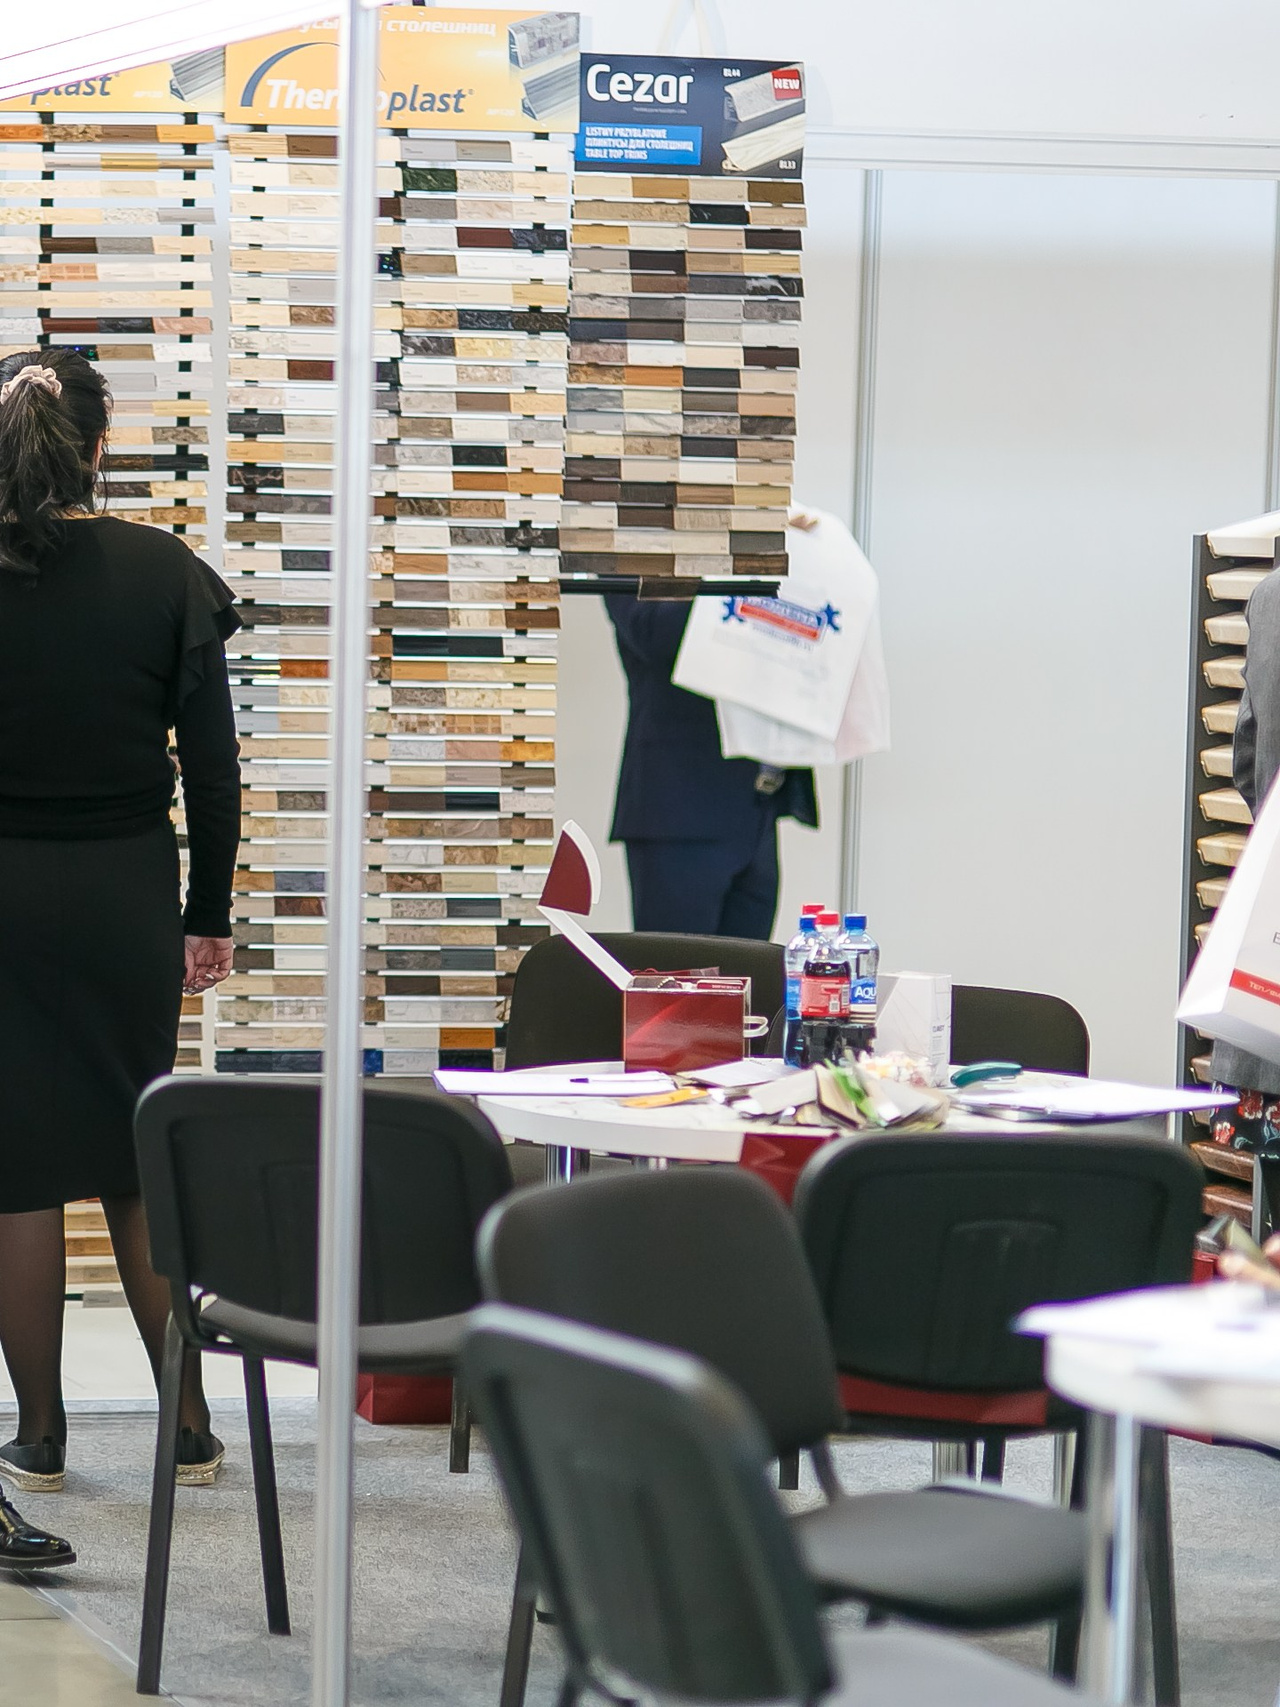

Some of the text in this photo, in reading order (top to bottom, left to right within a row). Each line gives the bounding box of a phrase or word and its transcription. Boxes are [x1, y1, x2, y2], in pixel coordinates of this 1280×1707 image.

[266, 78, 466, 120] Theroplast
[586, 63, 694, 104] Cezar
[773, 78, 800, 90] NEW
